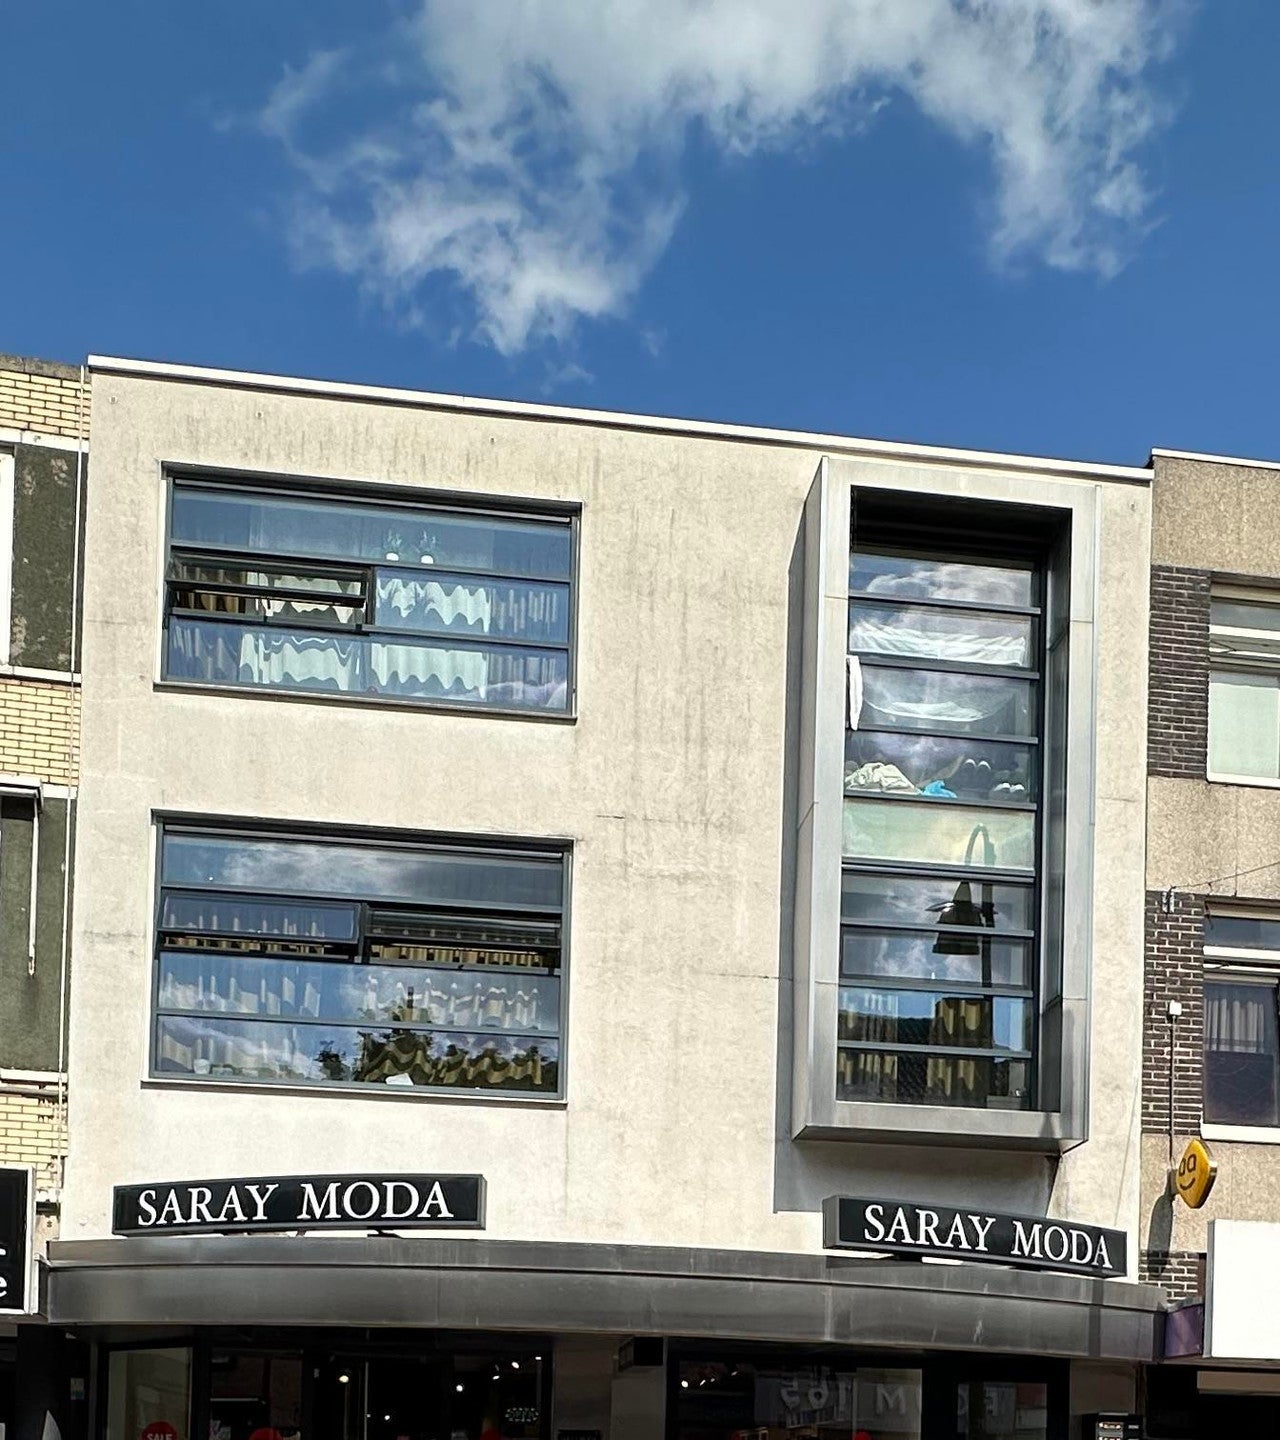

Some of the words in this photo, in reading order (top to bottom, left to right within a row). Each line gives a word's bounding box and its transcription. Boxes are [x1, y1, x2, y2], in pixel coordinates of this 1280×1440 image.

[137, 1184, 279, 1226] SARAY
[297, 1180, 454, 1220] MODA
[864, 1204, 996, 1252] SARAY
[1012, 1221, 1114, 1269] MODA
